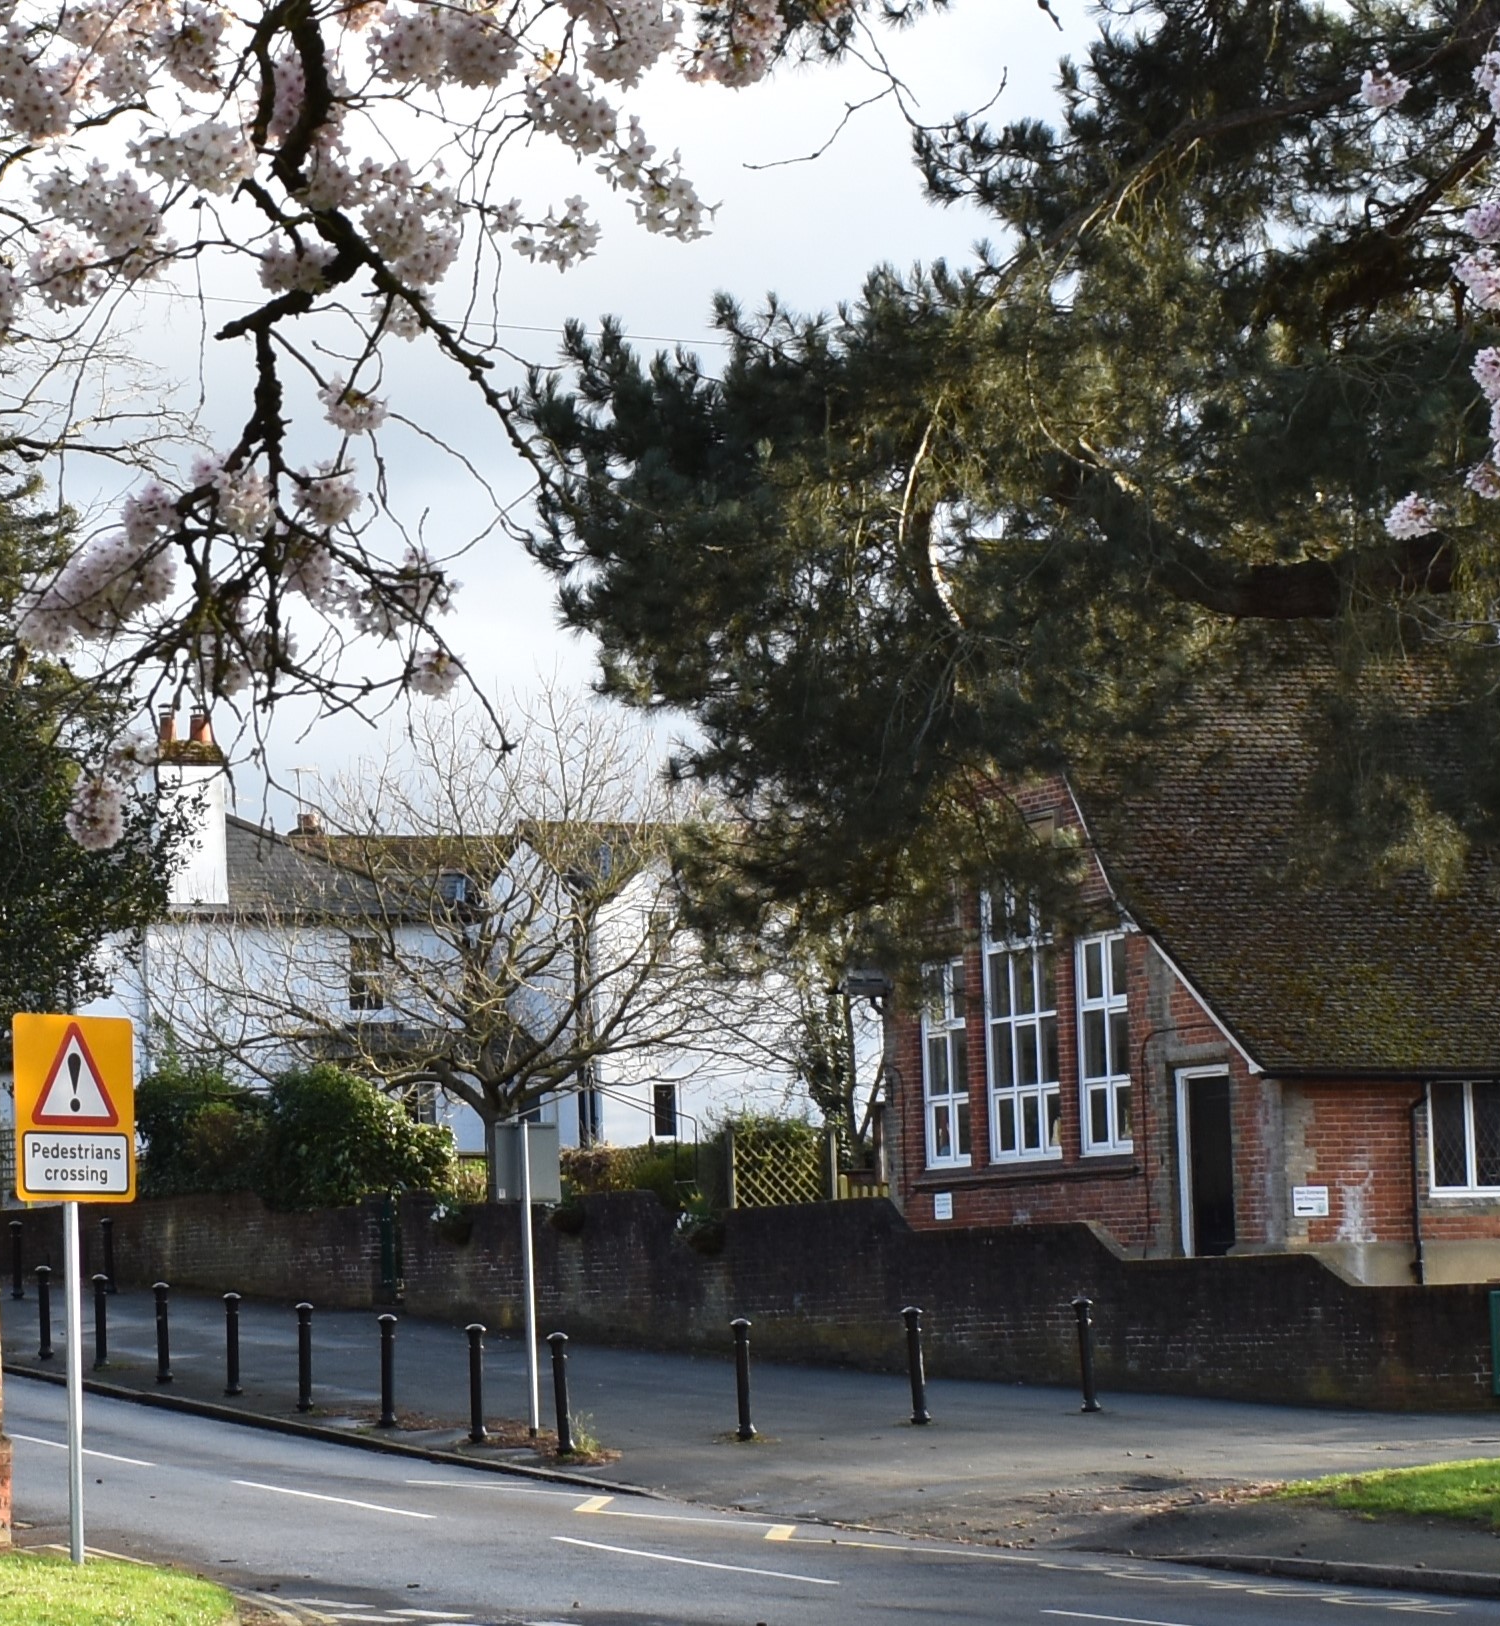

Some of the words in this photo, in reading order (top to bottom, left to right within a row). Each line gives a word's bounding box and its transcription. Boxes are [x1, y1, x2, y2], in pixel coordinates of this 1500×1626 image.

[31, 1141, 121, 1161] Pedestrians
[44, 1165, 108, 1185] crossing
[1038, 1562, 1470, 1616] SCHOOL
